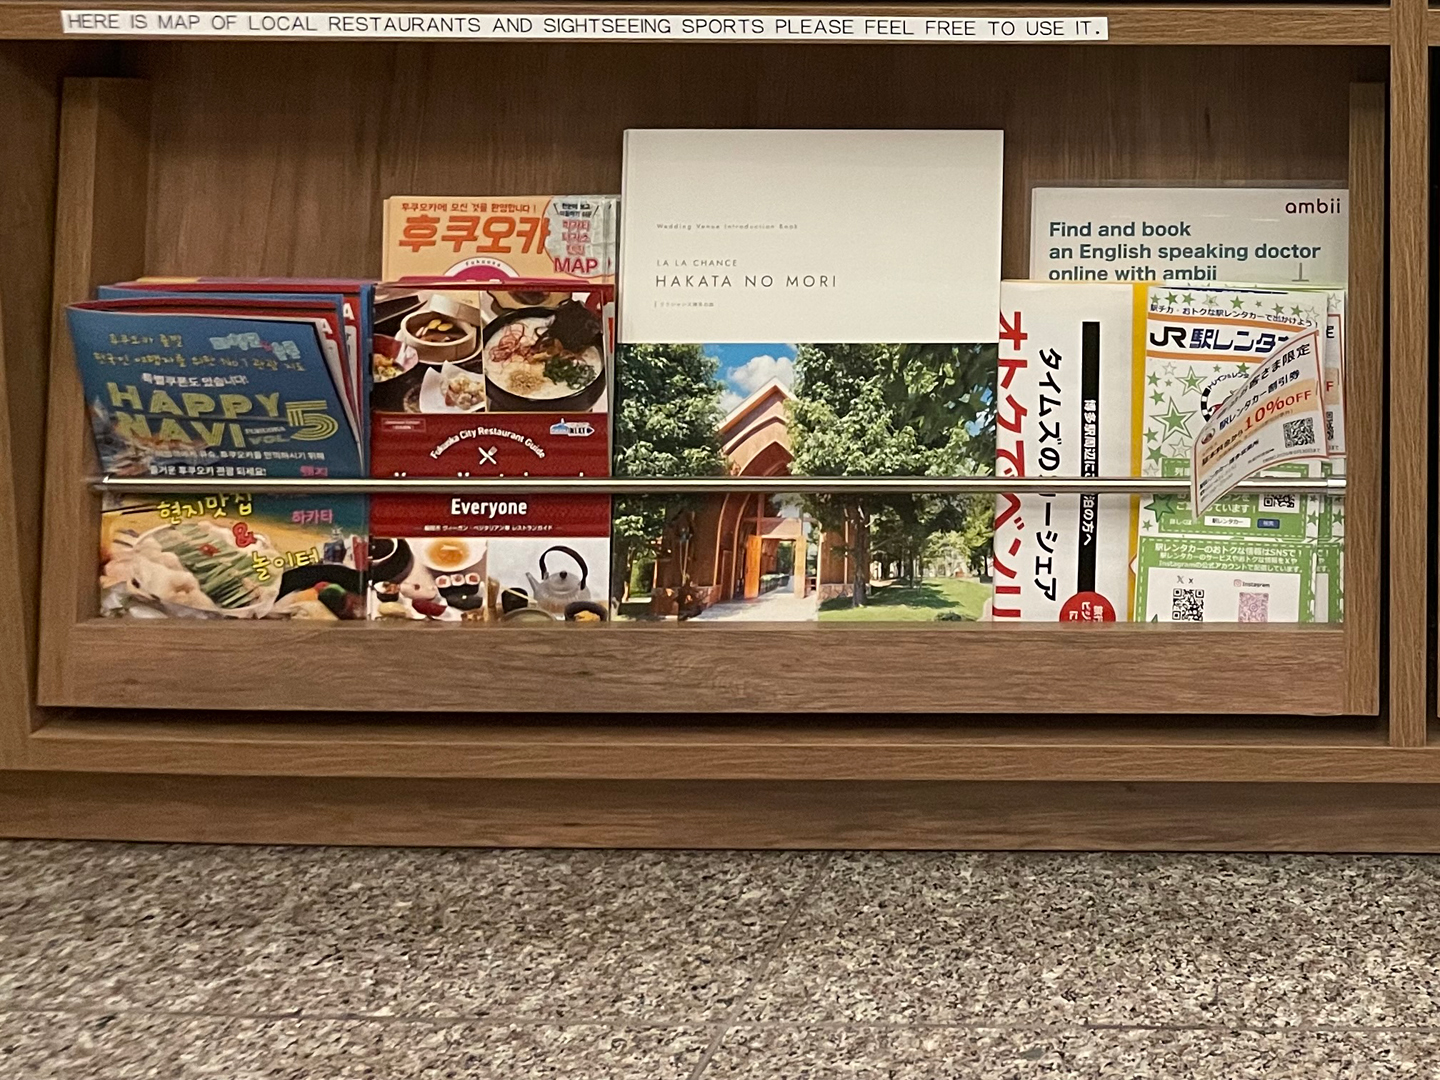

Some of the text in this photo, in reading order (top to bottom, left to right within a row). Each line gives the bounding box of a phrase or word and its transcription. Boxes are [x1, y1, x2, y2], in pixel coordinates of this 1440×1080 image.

[68, 13, 1101, 36] HERE IS MAP OF LOCAL RESTAURANTS AND SIGHTSEEING SPORTS PLEASE FEEL FREE TO USE IT.
[1285, 198, 1341, 214] ambii
[399, 214, 551, 254] 후쿠오카
[1049, 221, 1192, 237] Find and book
[656, 259, 738, 267] LA LA CHANCE
[1049, 243, 1321, 262] an English speaking doctor
[554, 257, 598, 273] MAP
[1049, 266, 1217, 281] online with ambii
[655, 275, 837, 288] HAKATA NO MORI
[1150, 326, 1290, 353] JR 駅レンタ
[106, 382, 280, 419] HAPPY
[1244, 390, 1312, 430] 10%OFF
[113, 411, 246, 448] NAVI
[285, 400, 339, 441] 5
[430, 426, 546, 460] Fukuoka City Restaurant Guide
[1034, 347, 1062, 602] タイムズのーシェア
[292, 510, 333, 525] 하카타
[451, 498, 528, 518] Everyone
[252, 547, 321, 581] 놀이터
